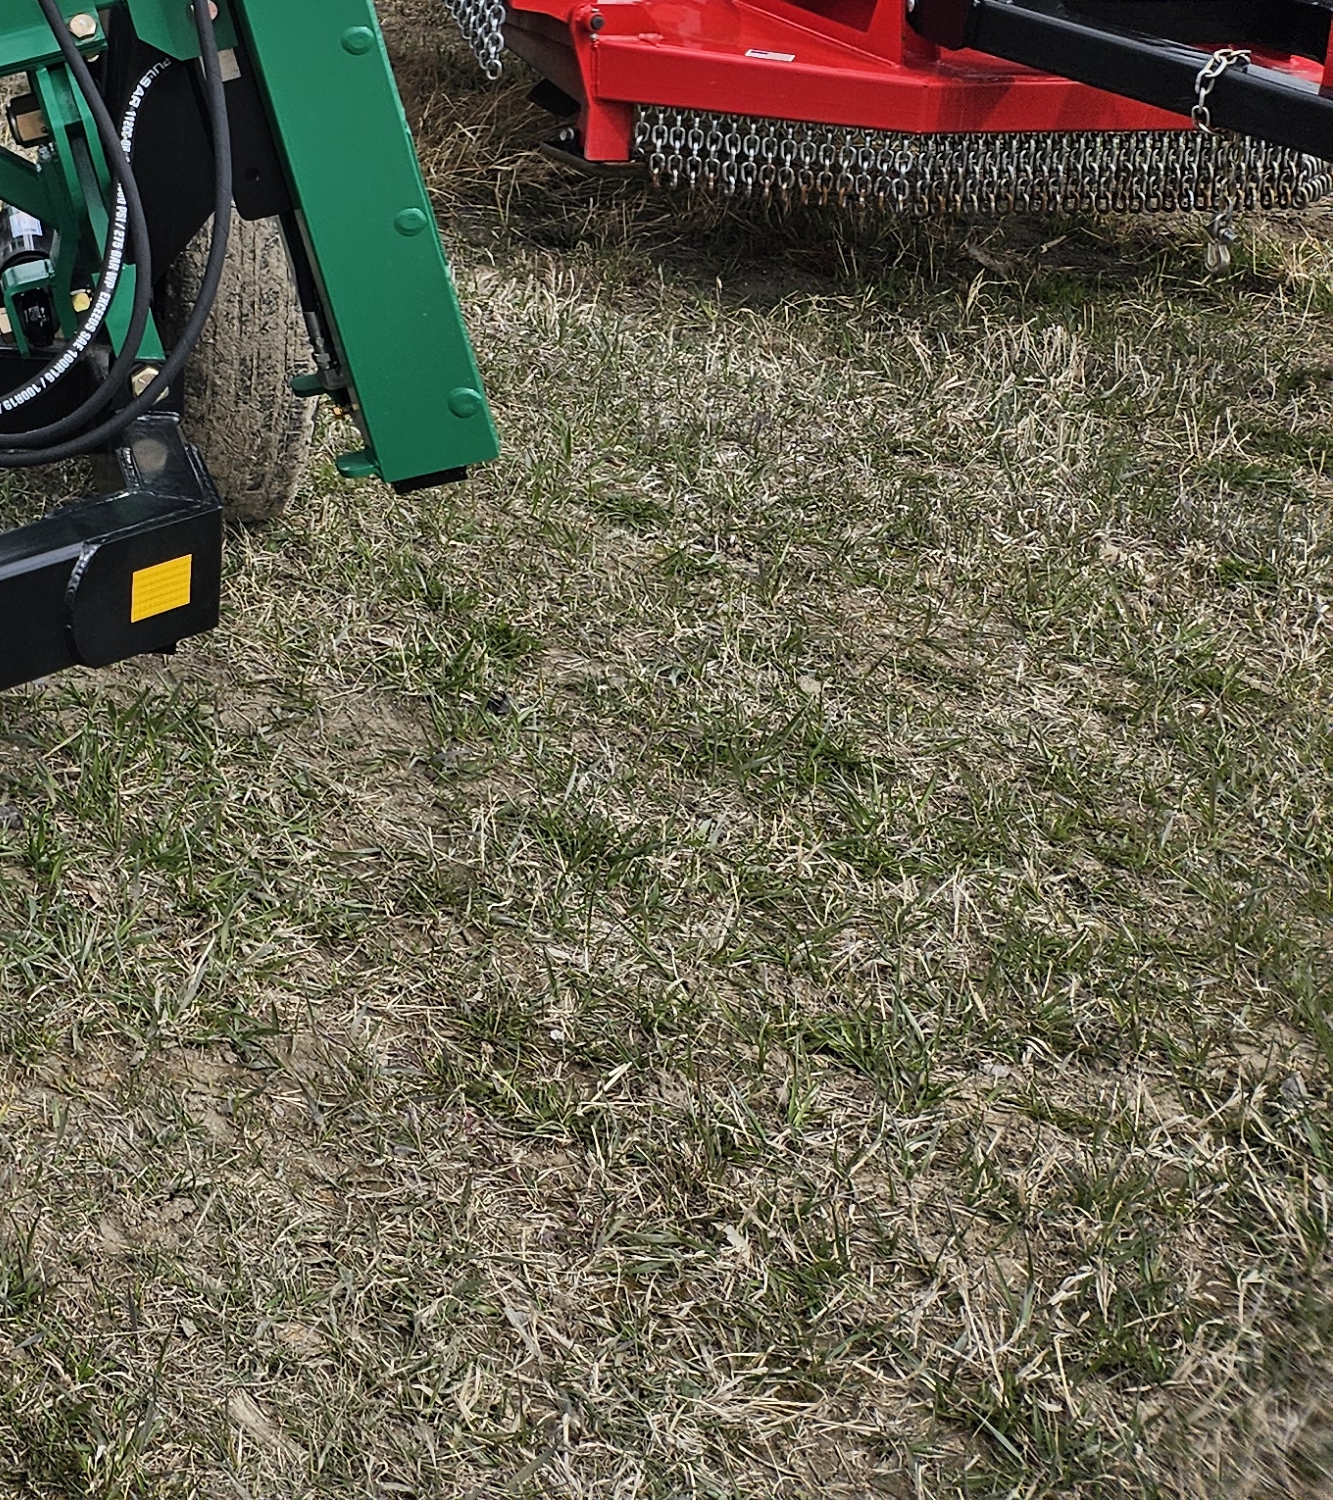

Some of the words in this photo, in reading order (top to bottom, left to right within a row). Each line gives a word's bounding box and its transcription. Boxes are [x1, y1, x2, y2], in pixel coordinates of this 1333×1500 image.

[128, 57, 172, 108] PULSAR
[115, 205, 128, 223] PSI
[112, 229, 126, 250] 275
[108, 249, 123, 271] BAR
[84, 291, 111, 333] EXCEEDS
[72, 330, 92, 351] SAE
